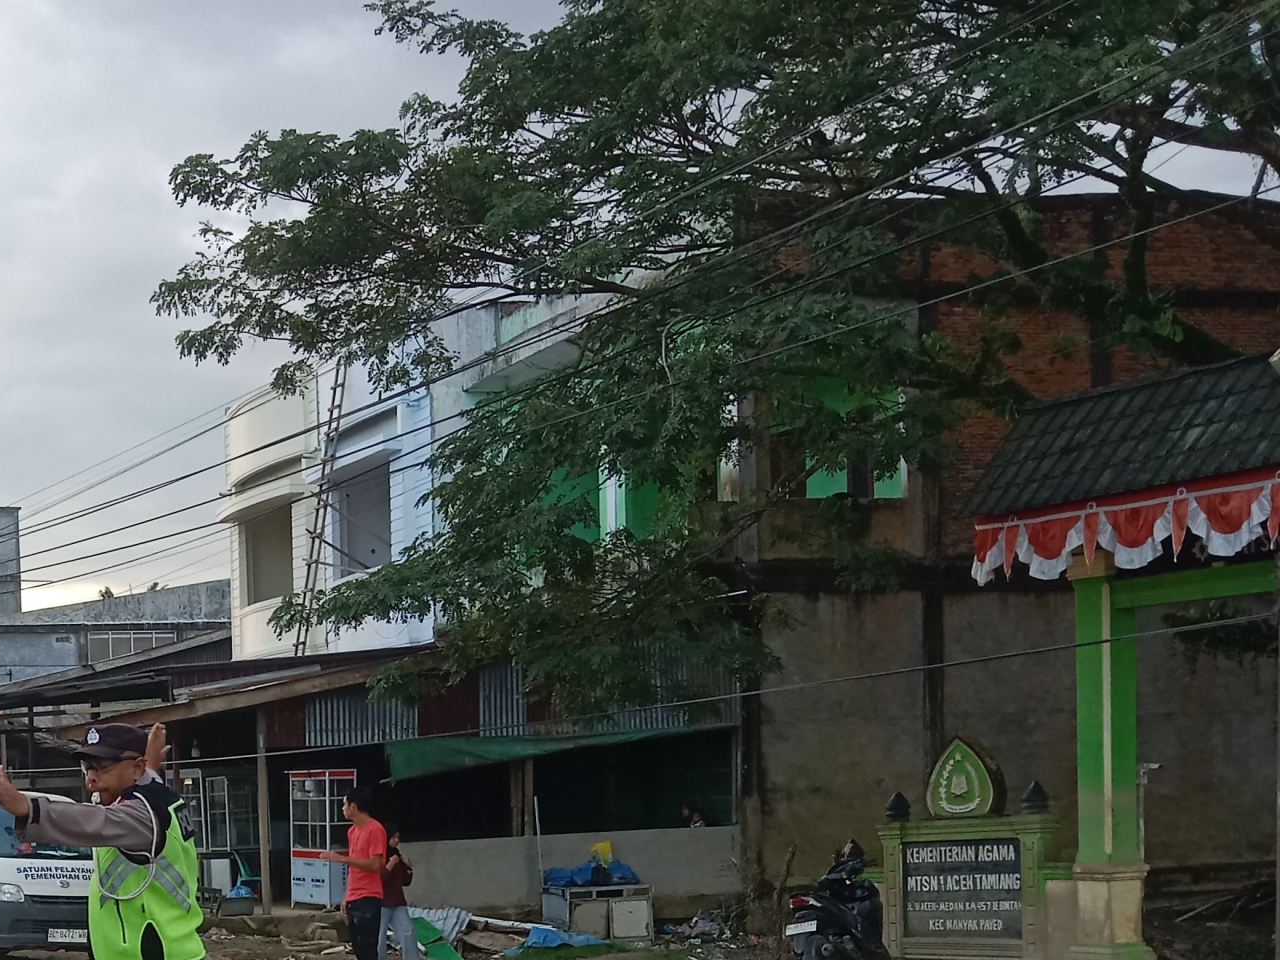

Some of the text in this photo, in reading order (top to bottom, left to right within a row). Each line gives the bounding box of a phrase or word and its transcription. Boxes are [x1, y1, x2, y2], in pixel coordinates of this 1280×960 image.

[906, 844, 1015, 863] KEMENTERIAN AGAMA
[16, 866, 52, 874] SATUAN
[907, 875, 938, 891] MTSN
[946, 874, 973, 891] ACEH
[974, 873, 1021, 890] TAMIANG
[929, 919, 1003, 931] KEC MANYAK PAYED
